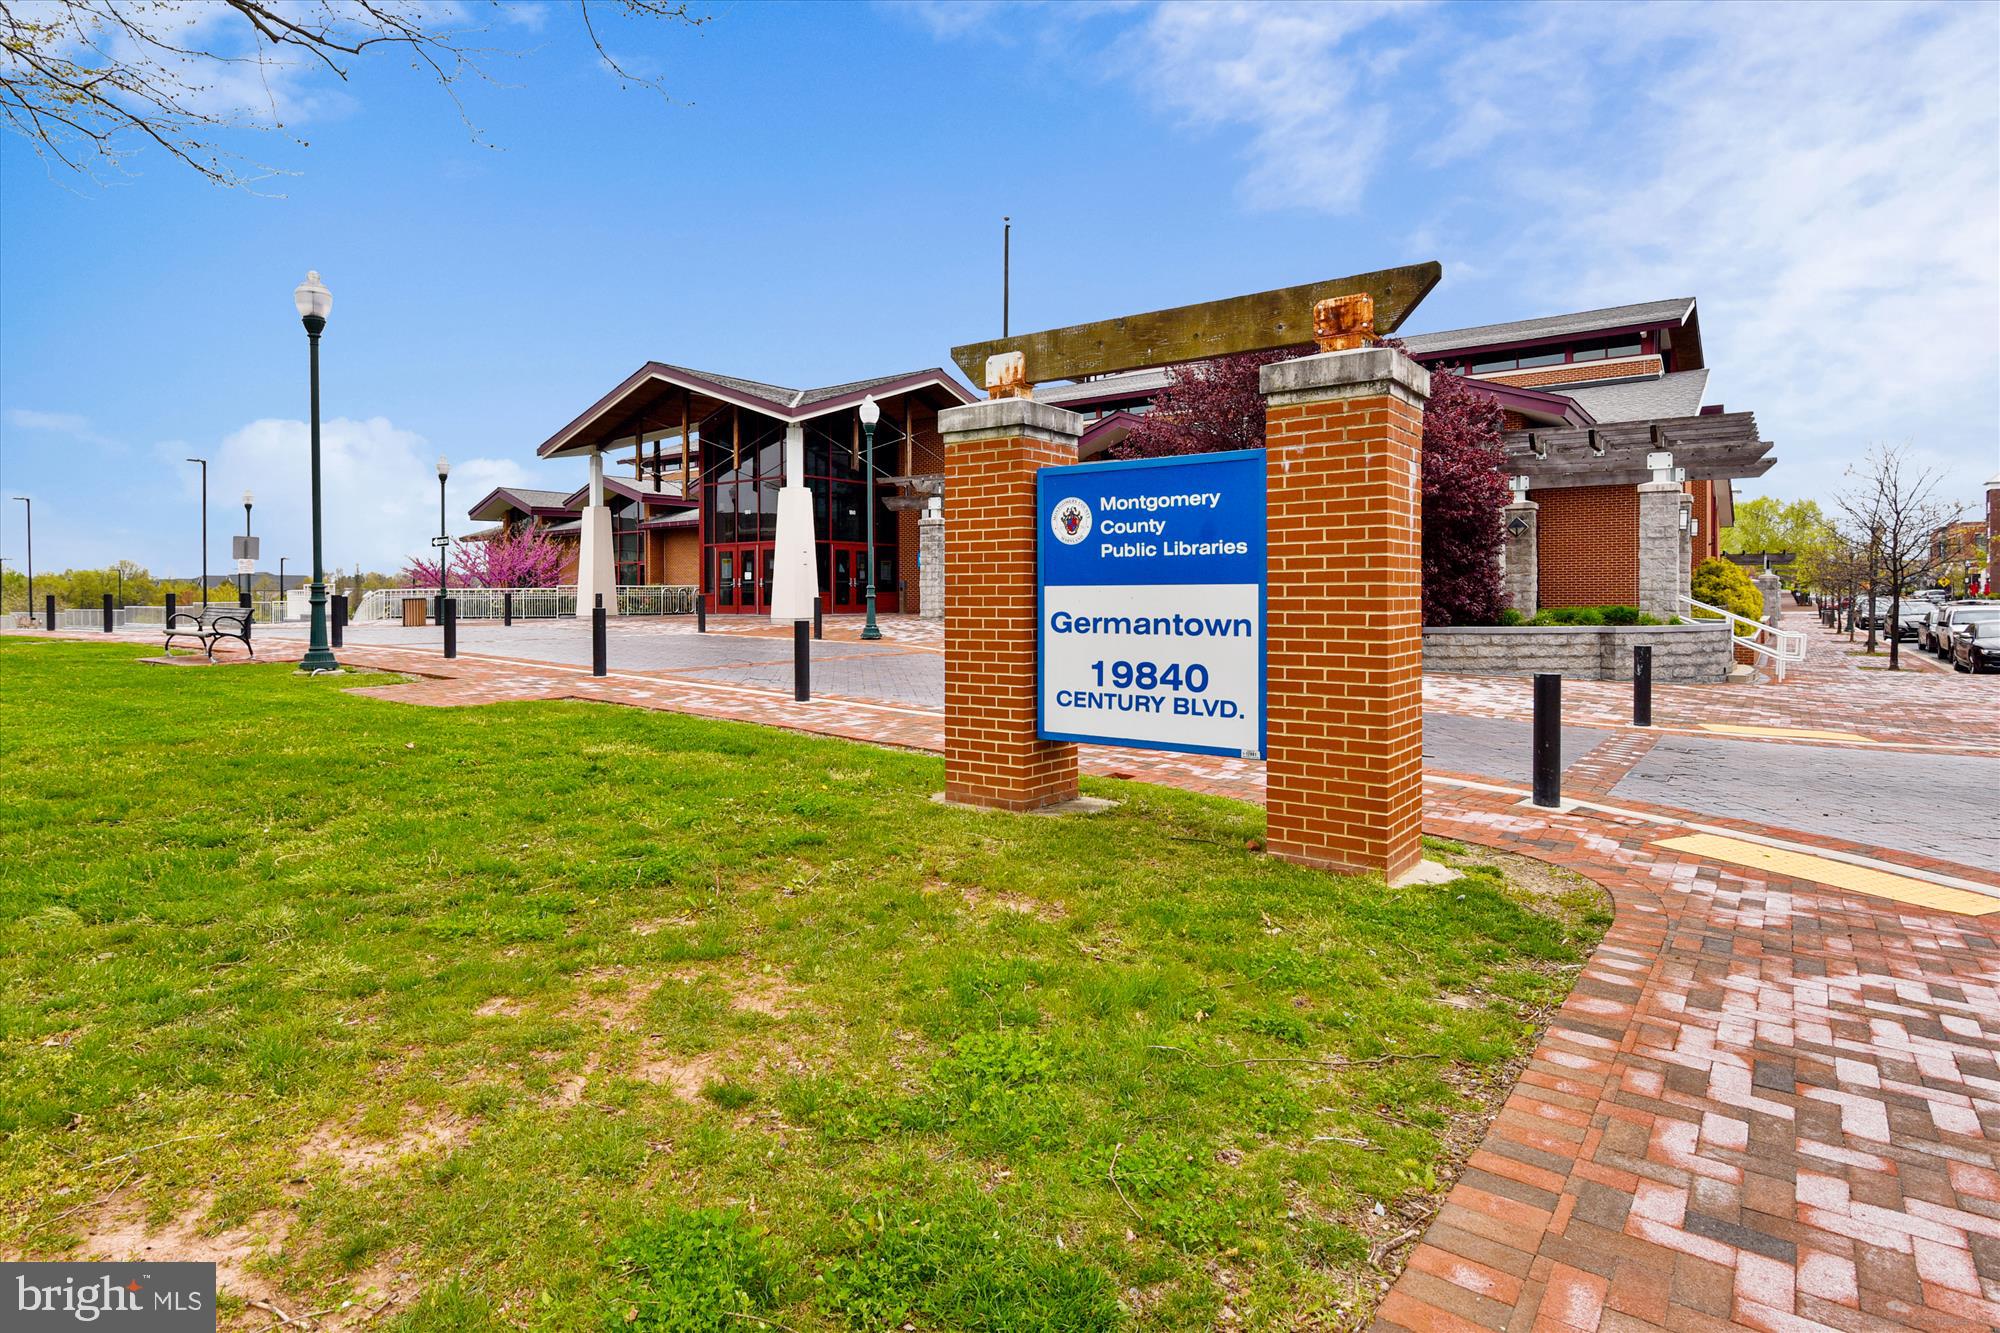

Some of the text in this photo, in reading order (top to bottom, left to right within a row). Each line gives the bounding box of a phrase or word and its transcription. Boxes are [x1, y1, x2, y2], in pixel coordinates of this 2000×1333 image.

[1100, 492, 1220, 511] Montgomery
[1100, 517, 1166, 536] County
[1101, 540, 1248, 558] Public Libraries
[1050, 611, 1252, 637] Germantown
[1091, 660, 1209, 692] 19840
[1056, 690, 1245, 719] CENTURY BLVD.
